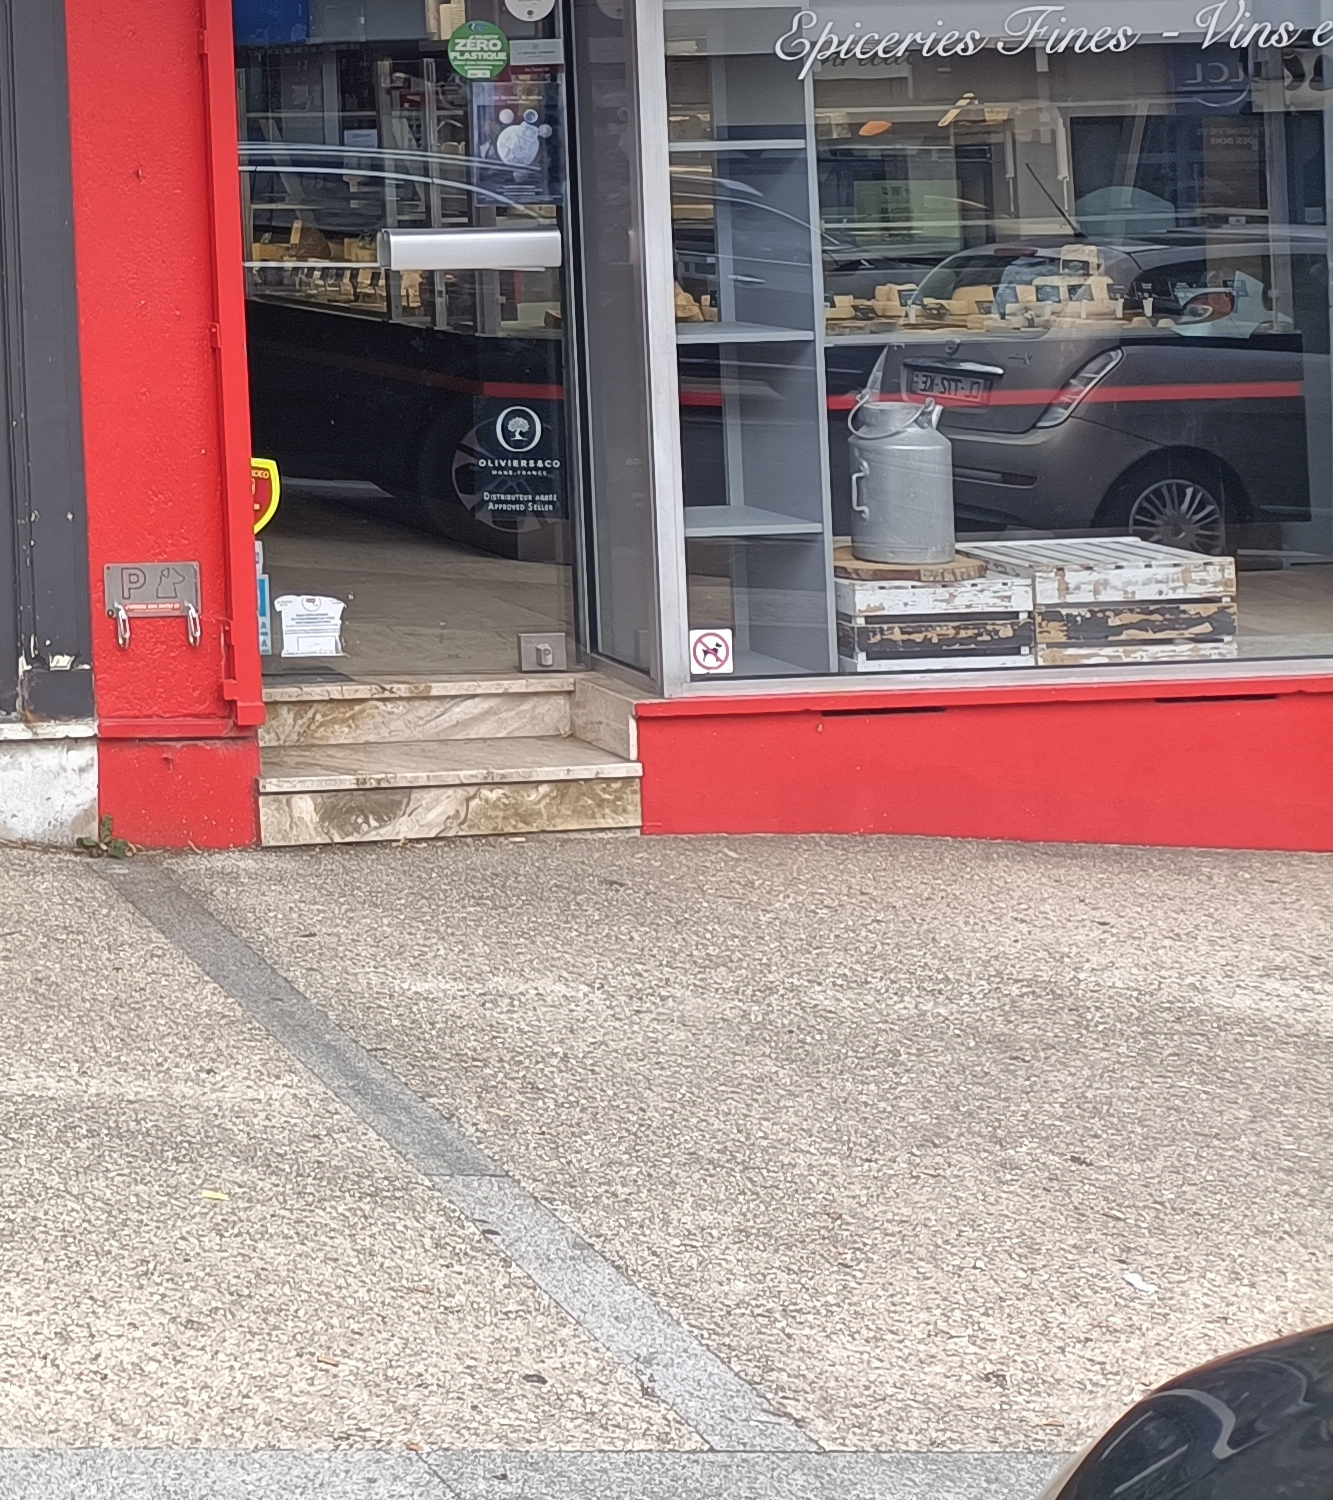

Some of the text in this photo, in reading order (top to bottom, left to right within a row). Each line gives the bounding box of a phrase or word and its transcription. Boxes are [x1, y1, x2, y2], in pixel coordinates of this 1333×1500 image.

[454, 35, 503, 51] ZÉRO
[773, 10, 991, 80] Epiceries
[997, 5, 1140, 56] Fines
[449, 51, 508, 61] PLASTIQUE
[478, 459, 561, 468] OLIVIERS&CO
[120, 567, 147, 600] P
